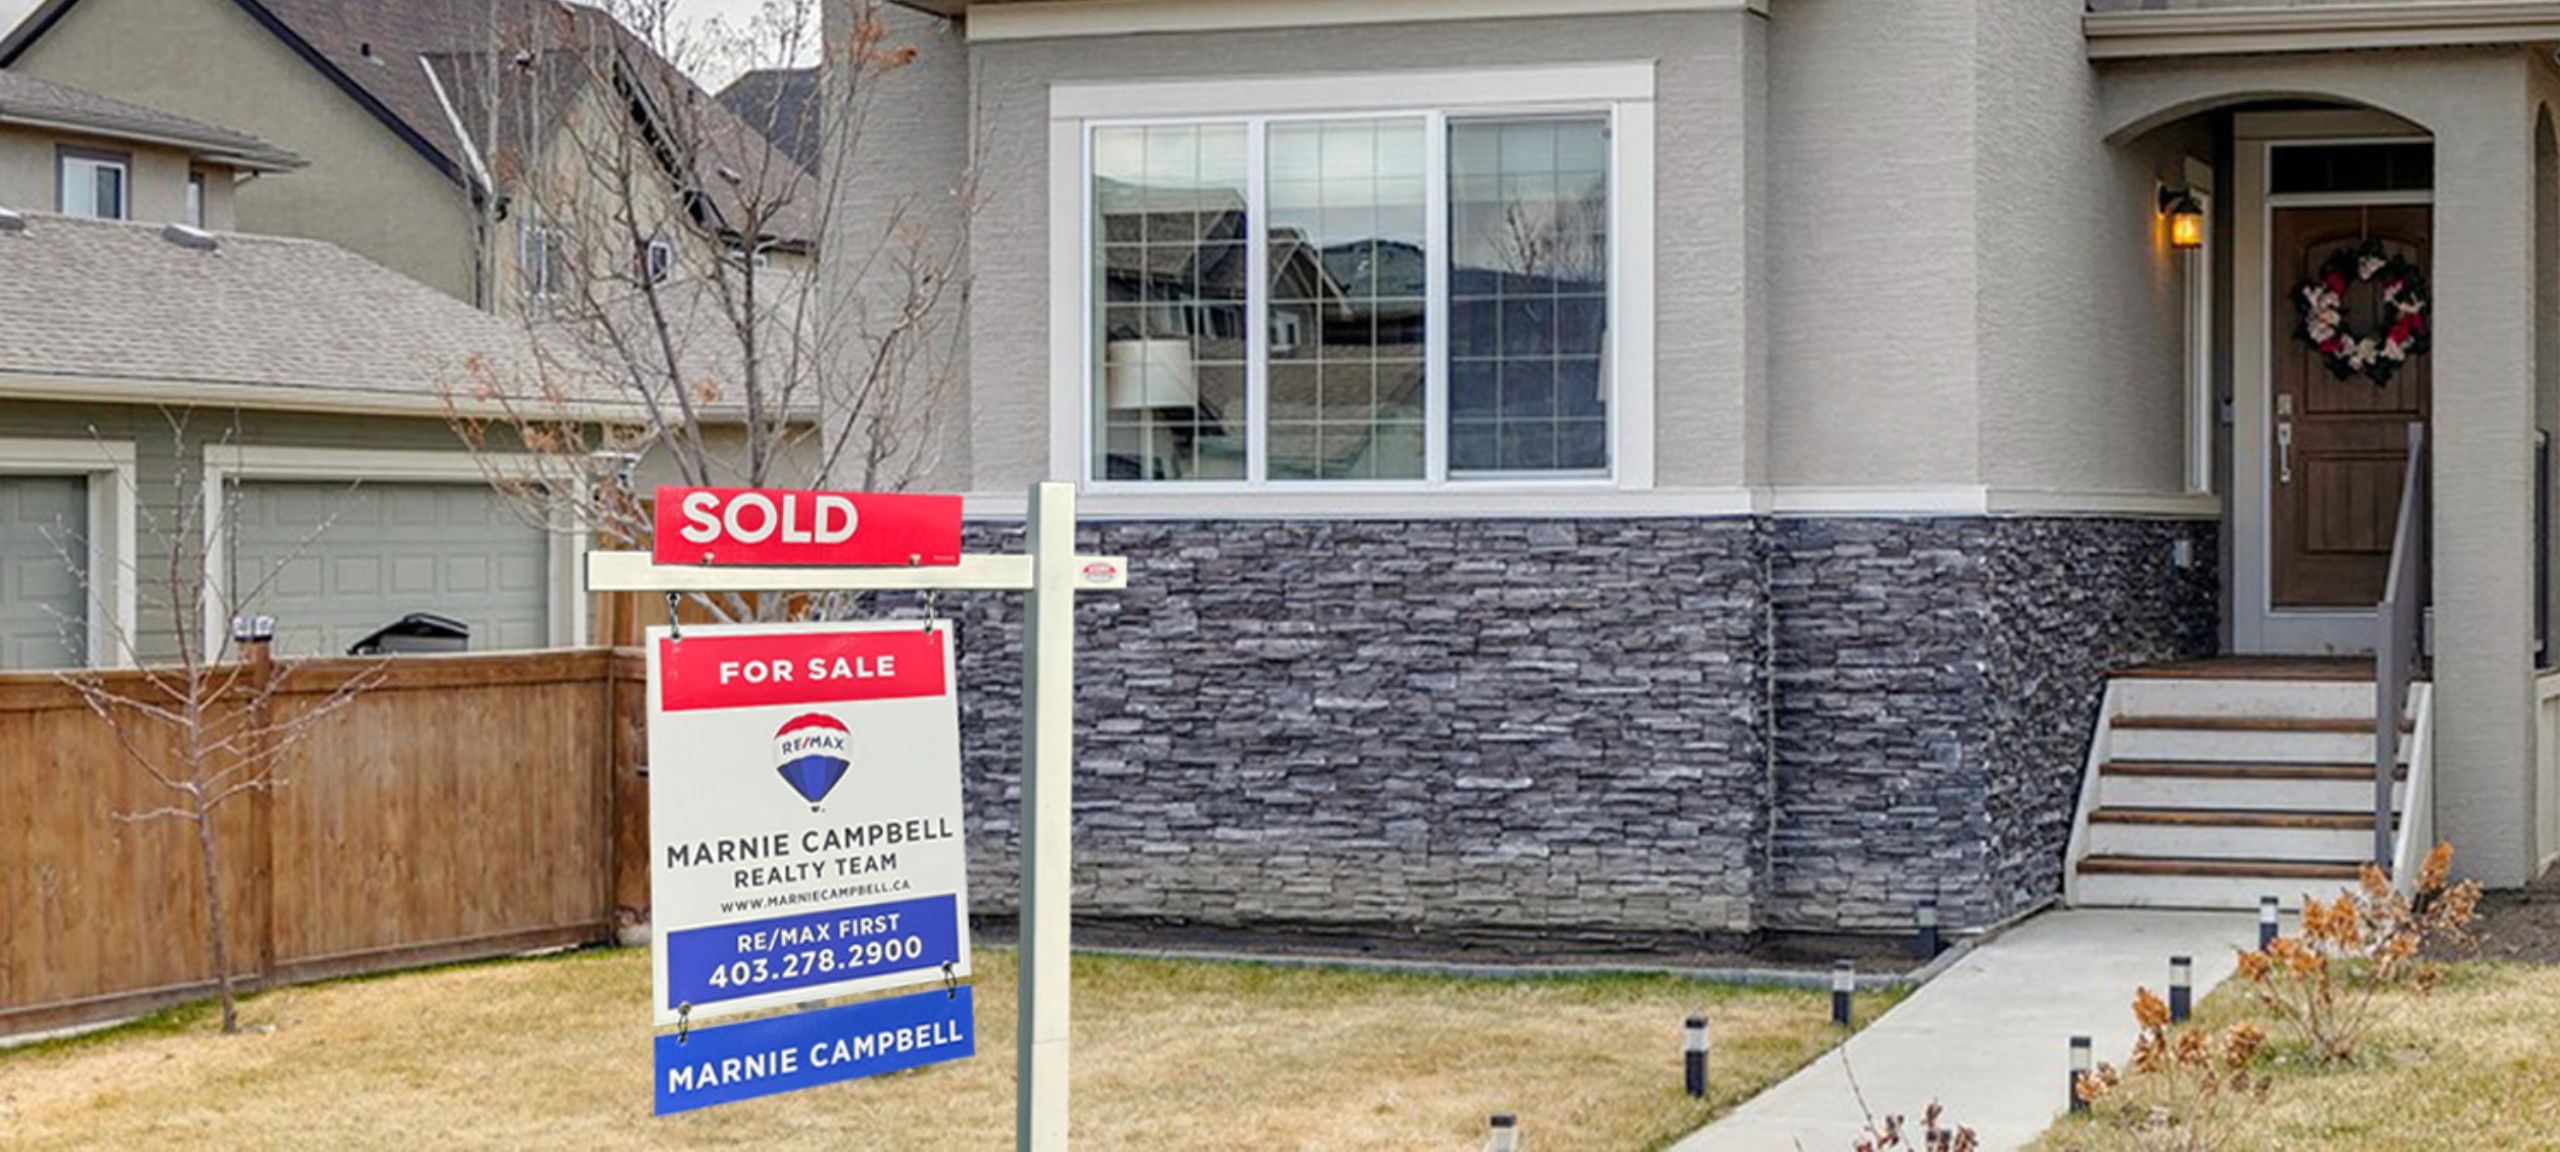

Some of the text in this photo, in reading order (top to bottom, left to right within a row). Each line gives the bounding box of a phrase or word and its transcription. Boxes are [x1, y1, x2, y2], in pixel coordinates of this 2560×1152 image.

[680, 491, 859, 544] SOLD
[719, 655, 896, 685] FOR SALE
[781, 735, 846, 755] RE/MAX
[667, 817, 953, 868] MARNIE CAMPBELL
[734, 853, 897, 889] REALTY TEAM
[720, 879, 911, 914] WWW.MARNIECAMPBELL.CA
[737, 913, 901, 953] RE/MAX FIRST
[708, 936, 923, 989] 403.278.2900
[668, 1020, 963, 1093] MARNIE CAMPBELL
